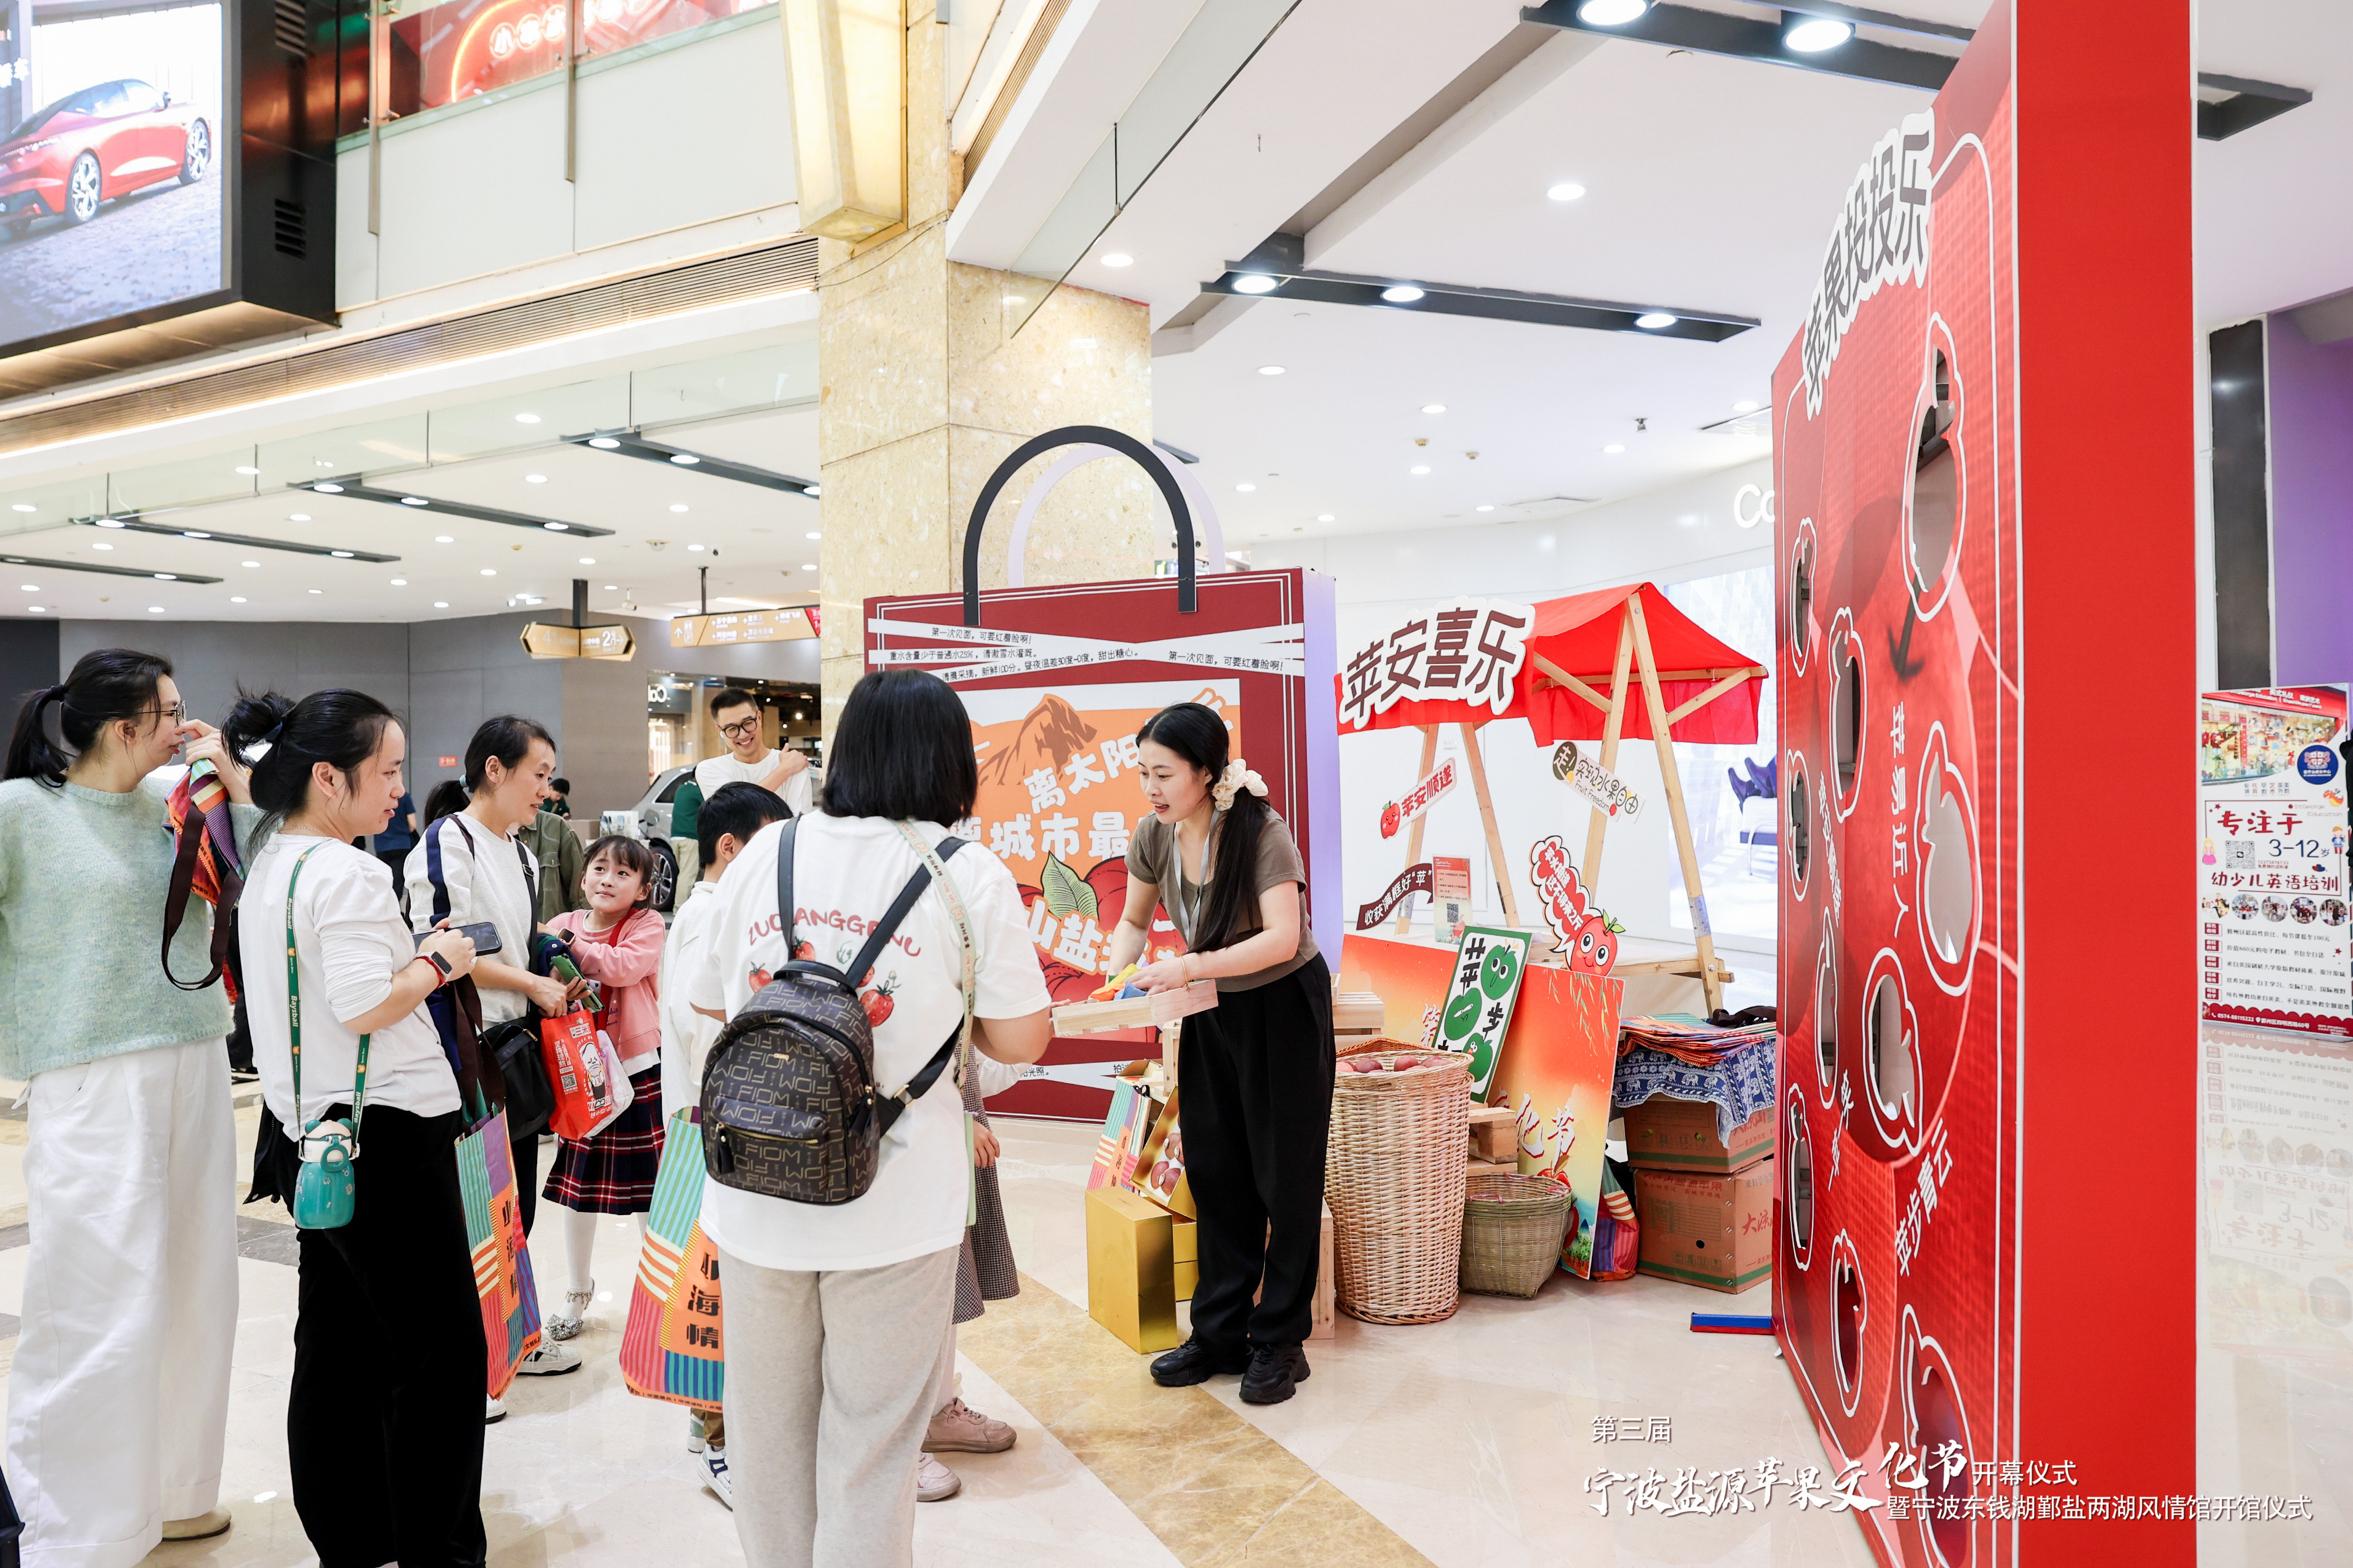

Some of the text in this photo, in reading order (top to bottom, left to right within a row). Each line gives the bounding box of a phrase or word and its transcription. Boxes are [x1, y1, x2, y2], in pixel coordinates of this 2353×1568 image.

[1805, 129, 1930, 403] 苹果投投乐
[1344, 607, 1526, 718] 苹安喜乐
[1401, 764, 1453, 818] 苹安顺遂
[1575, 758, 1638, 815] 实现水果自由
[1575, 779, 1610, 812] Fruit Freedom
[949, 810, 1146, 862] 城市最
[1889, 700, 1909, 939] 苹易近人
[2217, 810, 2303, 836] 专注于
[1818, 770, 1842, 928] 苹安顺遂
[2211, 871, 2338, 892] 幼少儿英语培训
[290, 995, 299, 1027] Baysball
[748, 1051, 797, 1072] FIOM
[353, 1091, 362, 1123] Baysball
[745, 1145, 800, 1163] FIOM
[1894, 1117, 1953, 1277] 苹步青云
[686, 1252, 720, 1349] 山海情
